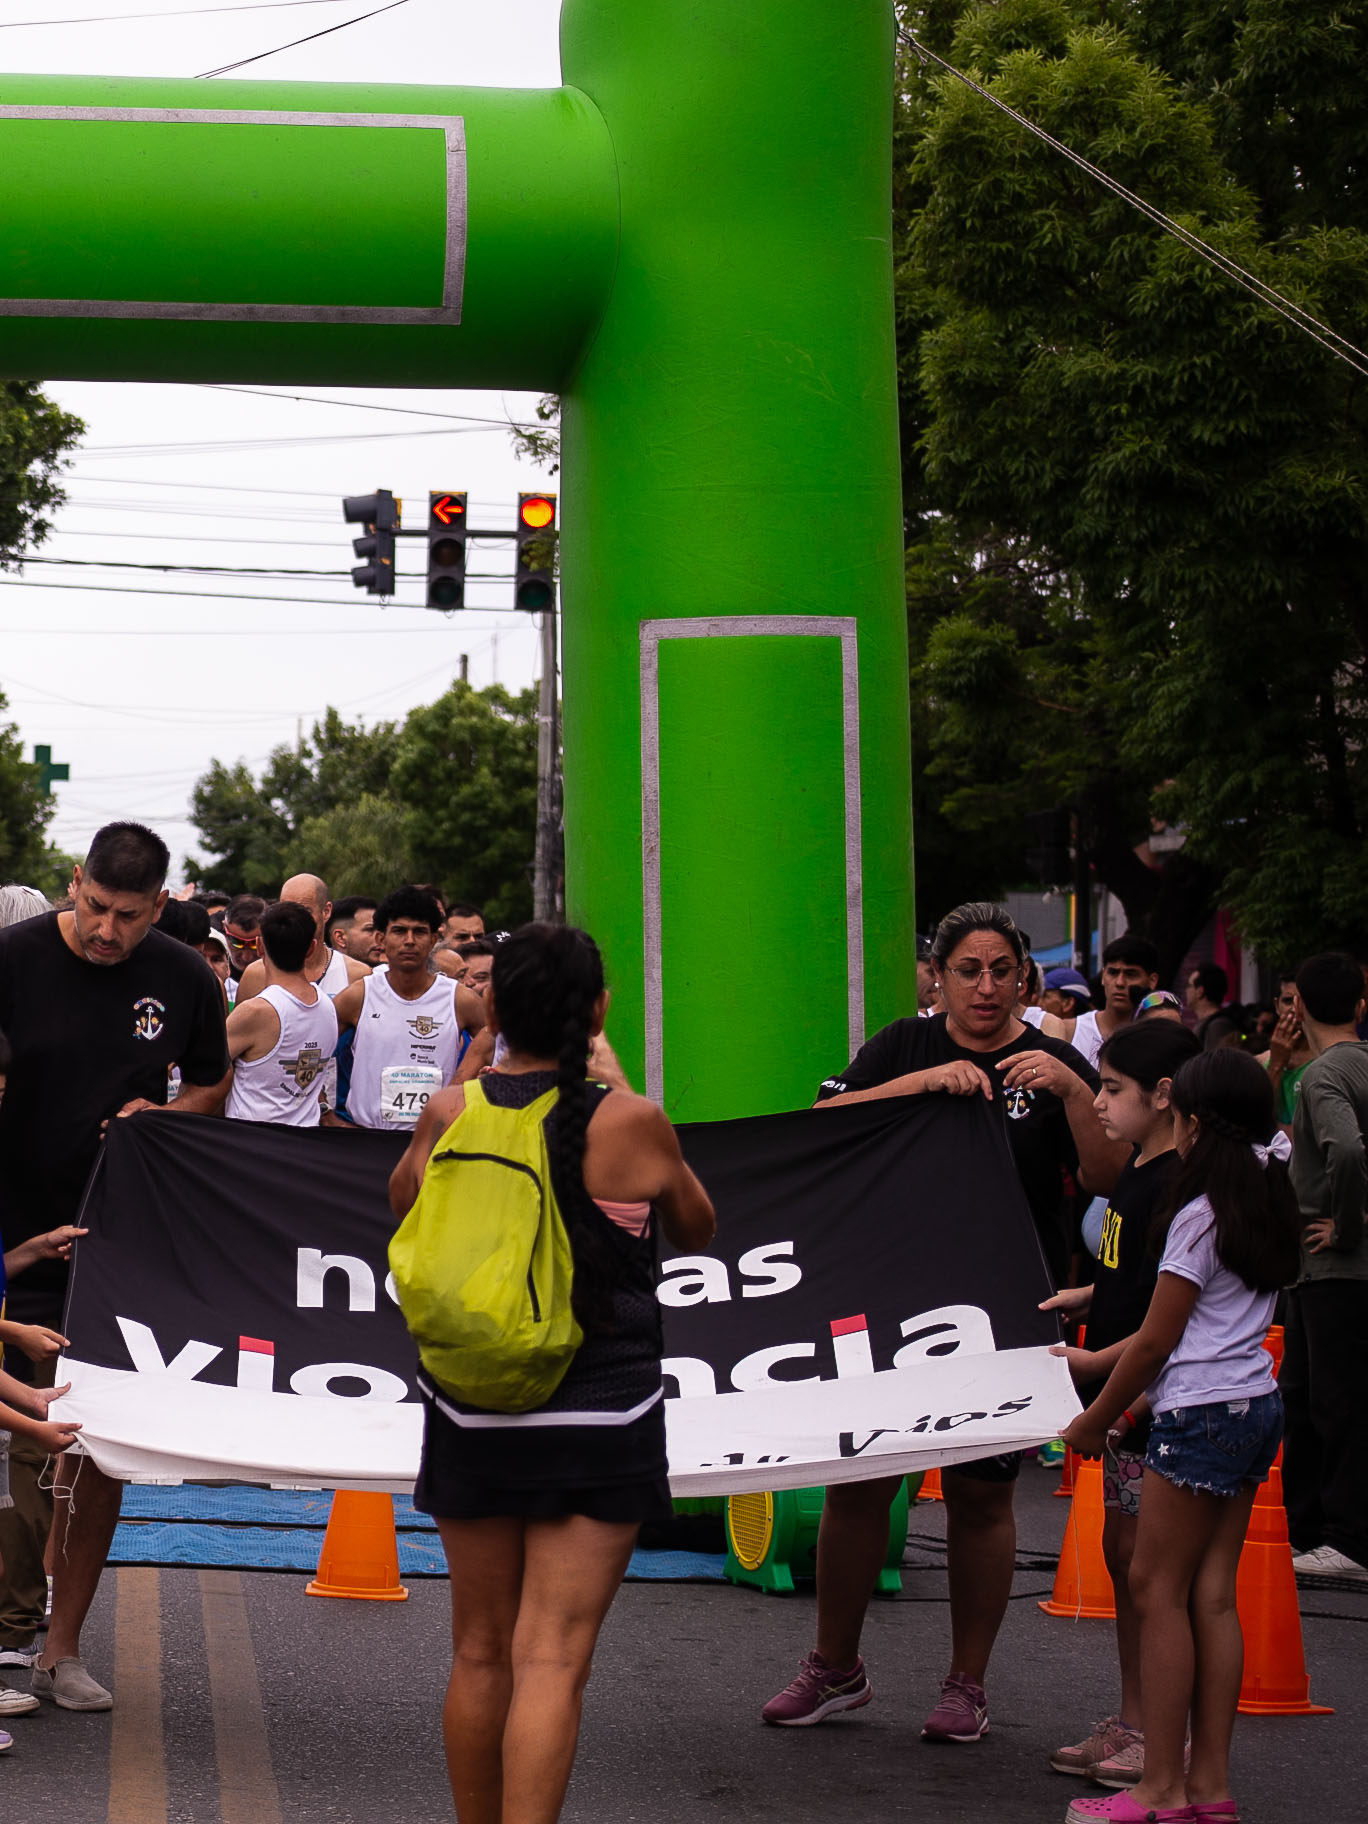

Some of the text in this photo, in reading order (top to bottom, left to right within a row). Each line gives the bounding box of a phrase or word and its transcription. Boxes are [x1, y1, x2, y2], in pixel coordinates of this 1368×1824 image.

[392, 1092, 431, 1111] 479
[296, 1240, 803, 1312] n as
